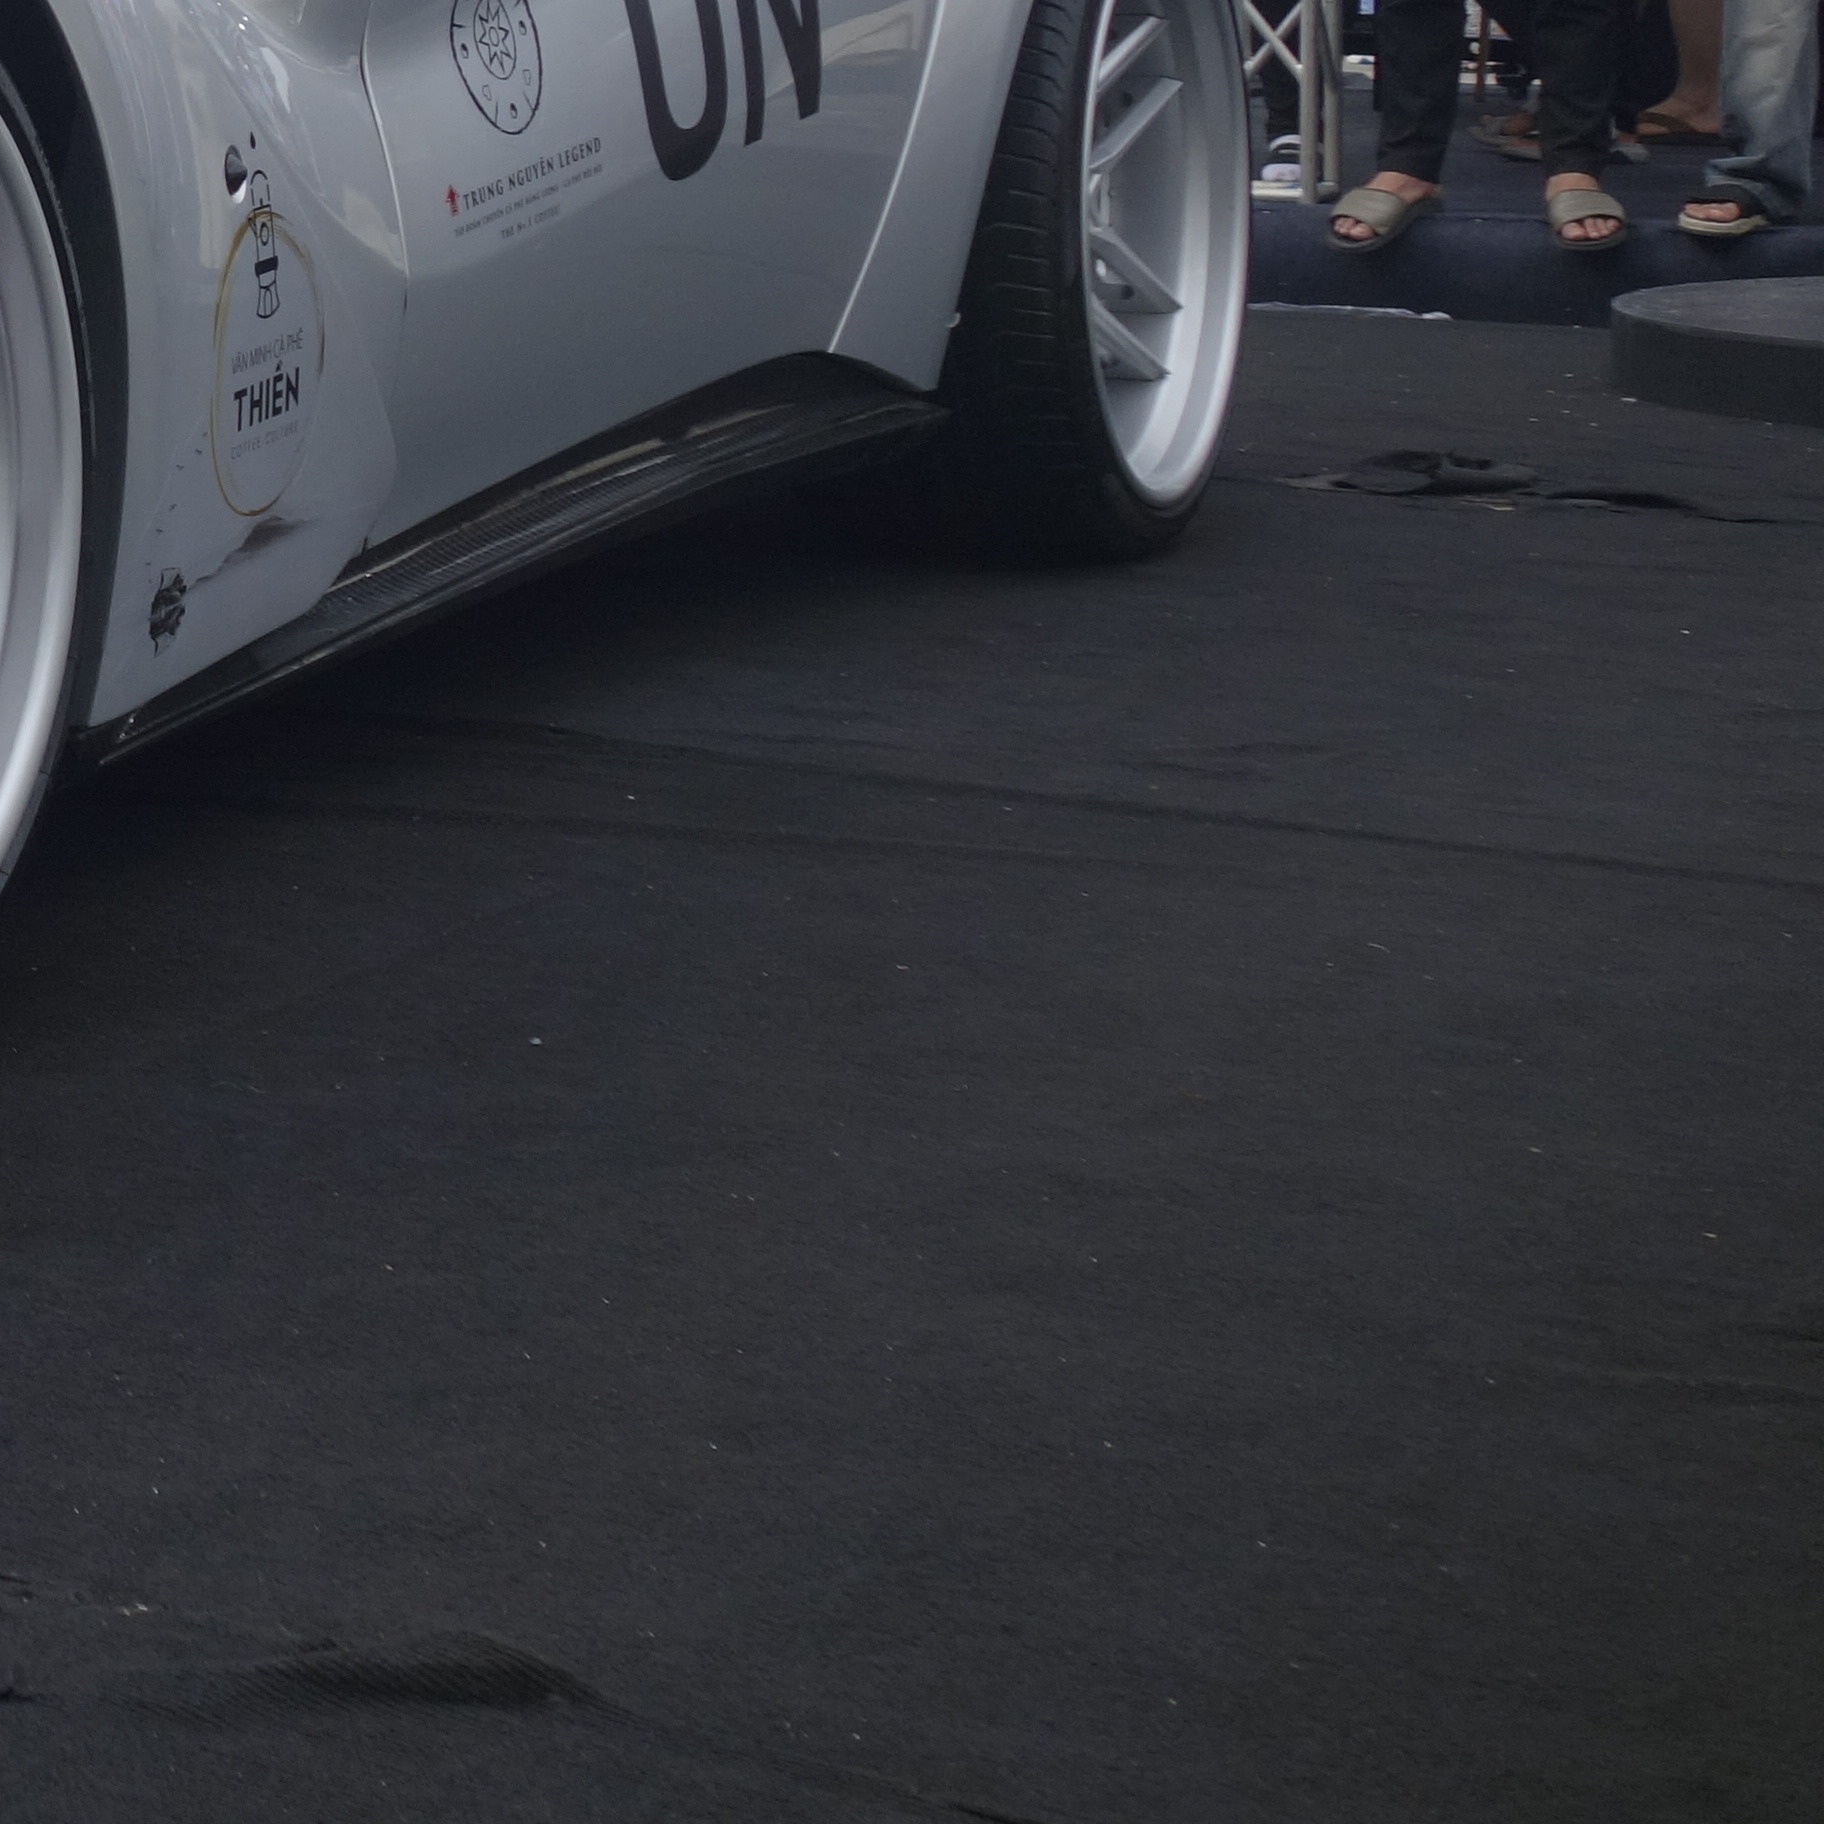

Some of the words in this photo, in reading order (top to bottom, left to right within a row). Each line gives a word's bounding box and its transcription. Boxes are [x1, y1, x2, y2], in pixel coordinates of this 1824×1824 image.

[463, 179, 504, 210] TRUNG
[508, 157, 554, 191] NGUYÊN
[558, 137, 602, 169] LEGEND
